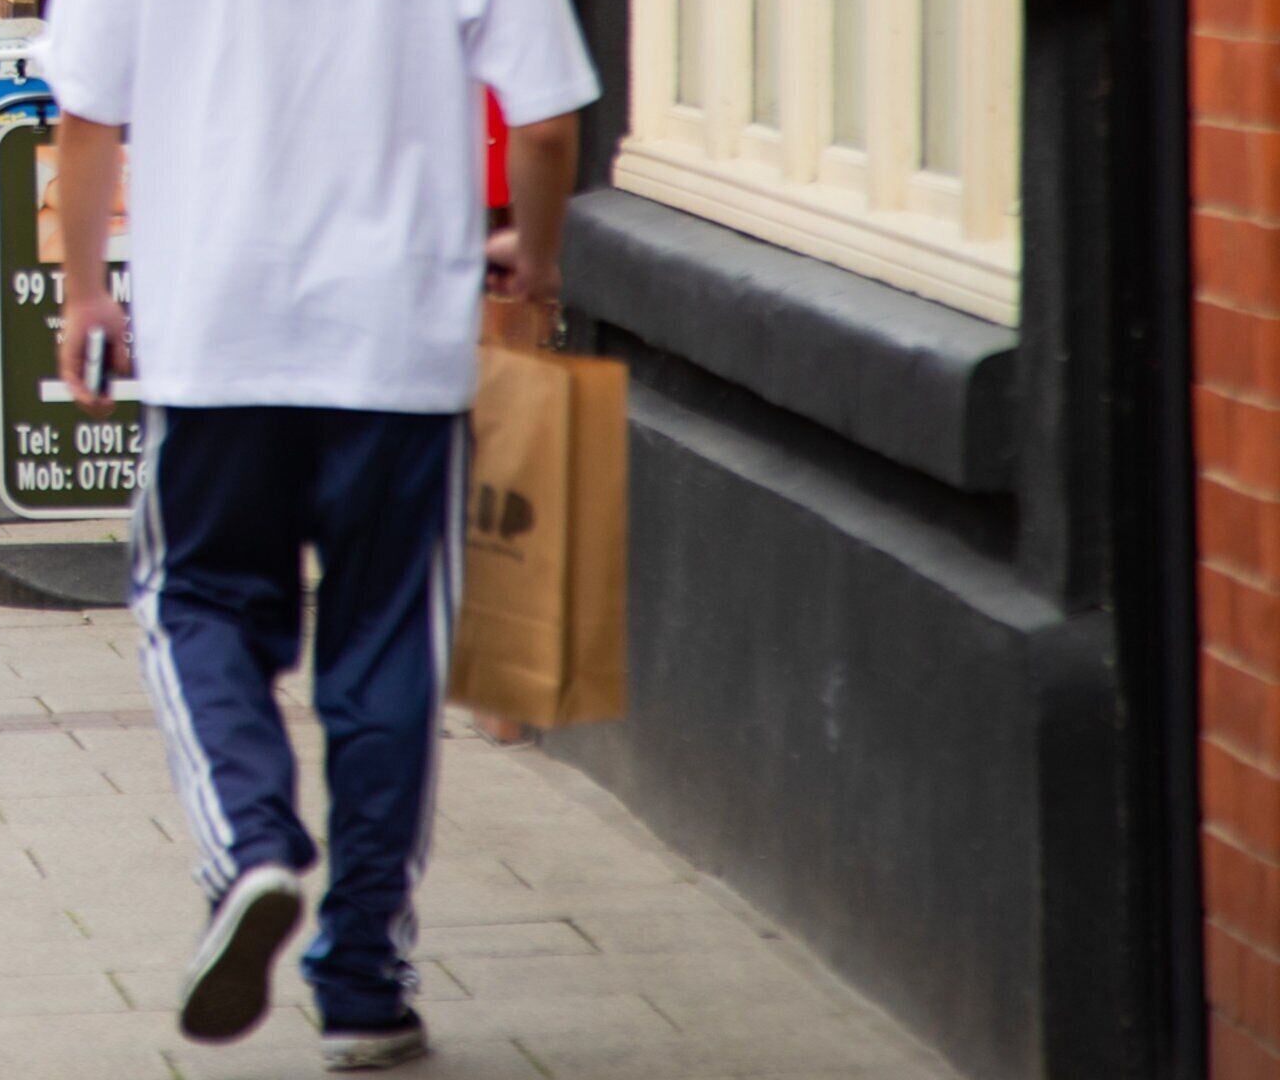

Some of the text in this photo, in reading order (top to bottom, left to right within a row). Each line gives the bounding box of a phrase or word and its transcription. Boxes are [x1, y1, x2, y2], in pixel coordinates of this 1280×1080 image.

[13, 272, 45, 306] 99
[16, 425, 59, 456] Tel:
[76, 424, 124, 456] 0191
[17, 462, 73, 491] Mob:
